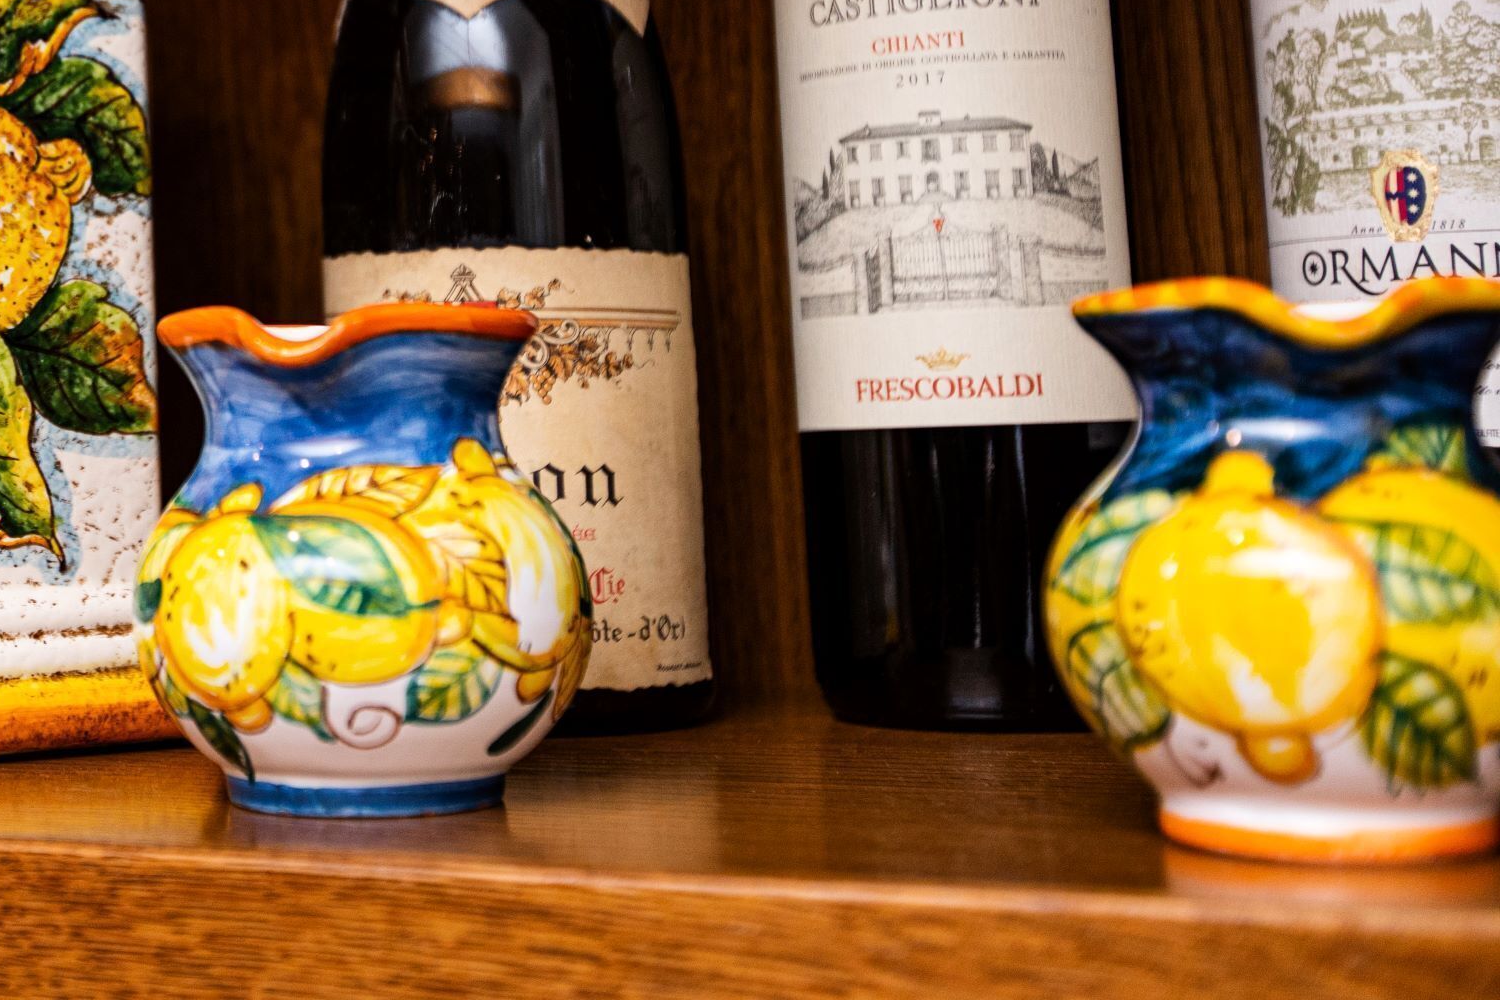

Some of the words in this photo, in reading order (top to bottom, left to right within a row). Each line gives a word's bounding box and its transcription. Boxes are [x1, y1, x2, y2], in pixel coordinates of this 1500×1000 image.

[871, 31, 964, 56] CHIANTI
[875, 57, 916, 70] ORIGINE
[920, 51, 998, 64] CONTROLLATA
[1003, 52, 1009, 61] E
[1013, 49, 1066, 62] GARANTITA
[896, 70, 946, 89] 2017
[1350, 224, 1384, 236] Anno
[1431, 219, 1467, 231] 1818
[1302, 242, 1500, 296] ORMAN
[855, 373, 1044, 402] FRESCOBALDI
